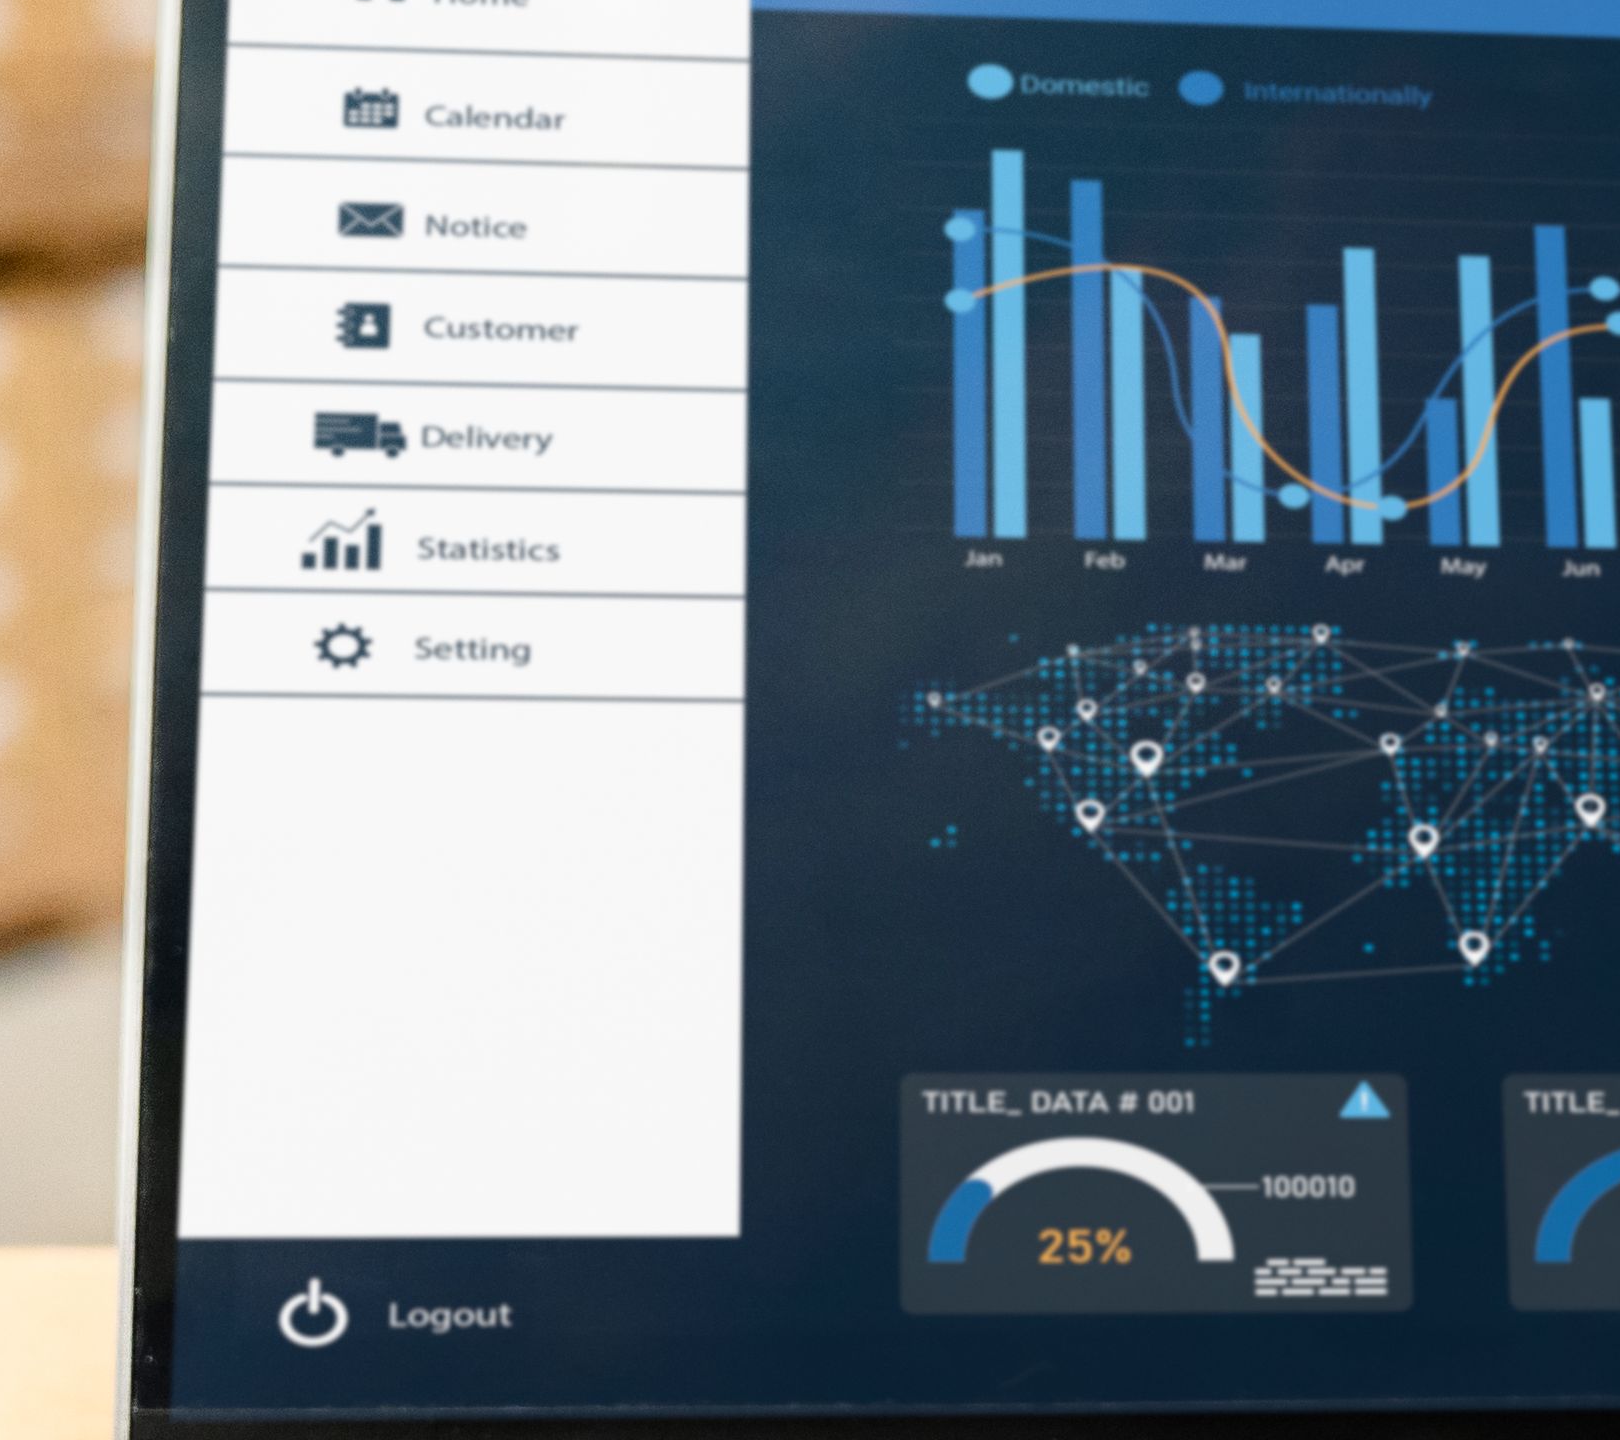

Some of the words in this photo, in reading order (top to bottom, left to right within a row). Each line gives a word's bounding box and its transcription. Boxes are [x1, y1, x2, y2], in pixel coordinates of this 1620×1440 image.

[1020, 74, 1148, 97] Domestic
[1243, 81, 1432, 109] Internationally
[425, 105, 564, 130] Calendar
[426, 215, 527, 238] Notice
[424, 316, 578, 341] Customer
[421, 425, 553, 456] Delivery
[418, 537, 560, 562] Statistics
[966, 550, 1003, 567] Jan
[1084, 551, 1126, 569] Feb
[1204, 553, 1246, 571] Mar
[1325, 555, 1364, 576] Apr
[1441, 557, 1486, 578] May
[1562, 560, 1601, 577] Jun
[415, 637, 531, 667] Setting
[922, 1090, 1021, 1116] TITLE_
[1031, 1090, 1109, 1113] DATA
[1119, 1092, 1138, 1112] #
[1148, 1090, 1194, 1113] 001
[1524, 1091, 1620, 1116] TITLE_
[1262, 1175, 1356, 1198] 100010
[1039, 1228, 1131, 1264] 25%
[389, 1302, 511, 1333] Logout
